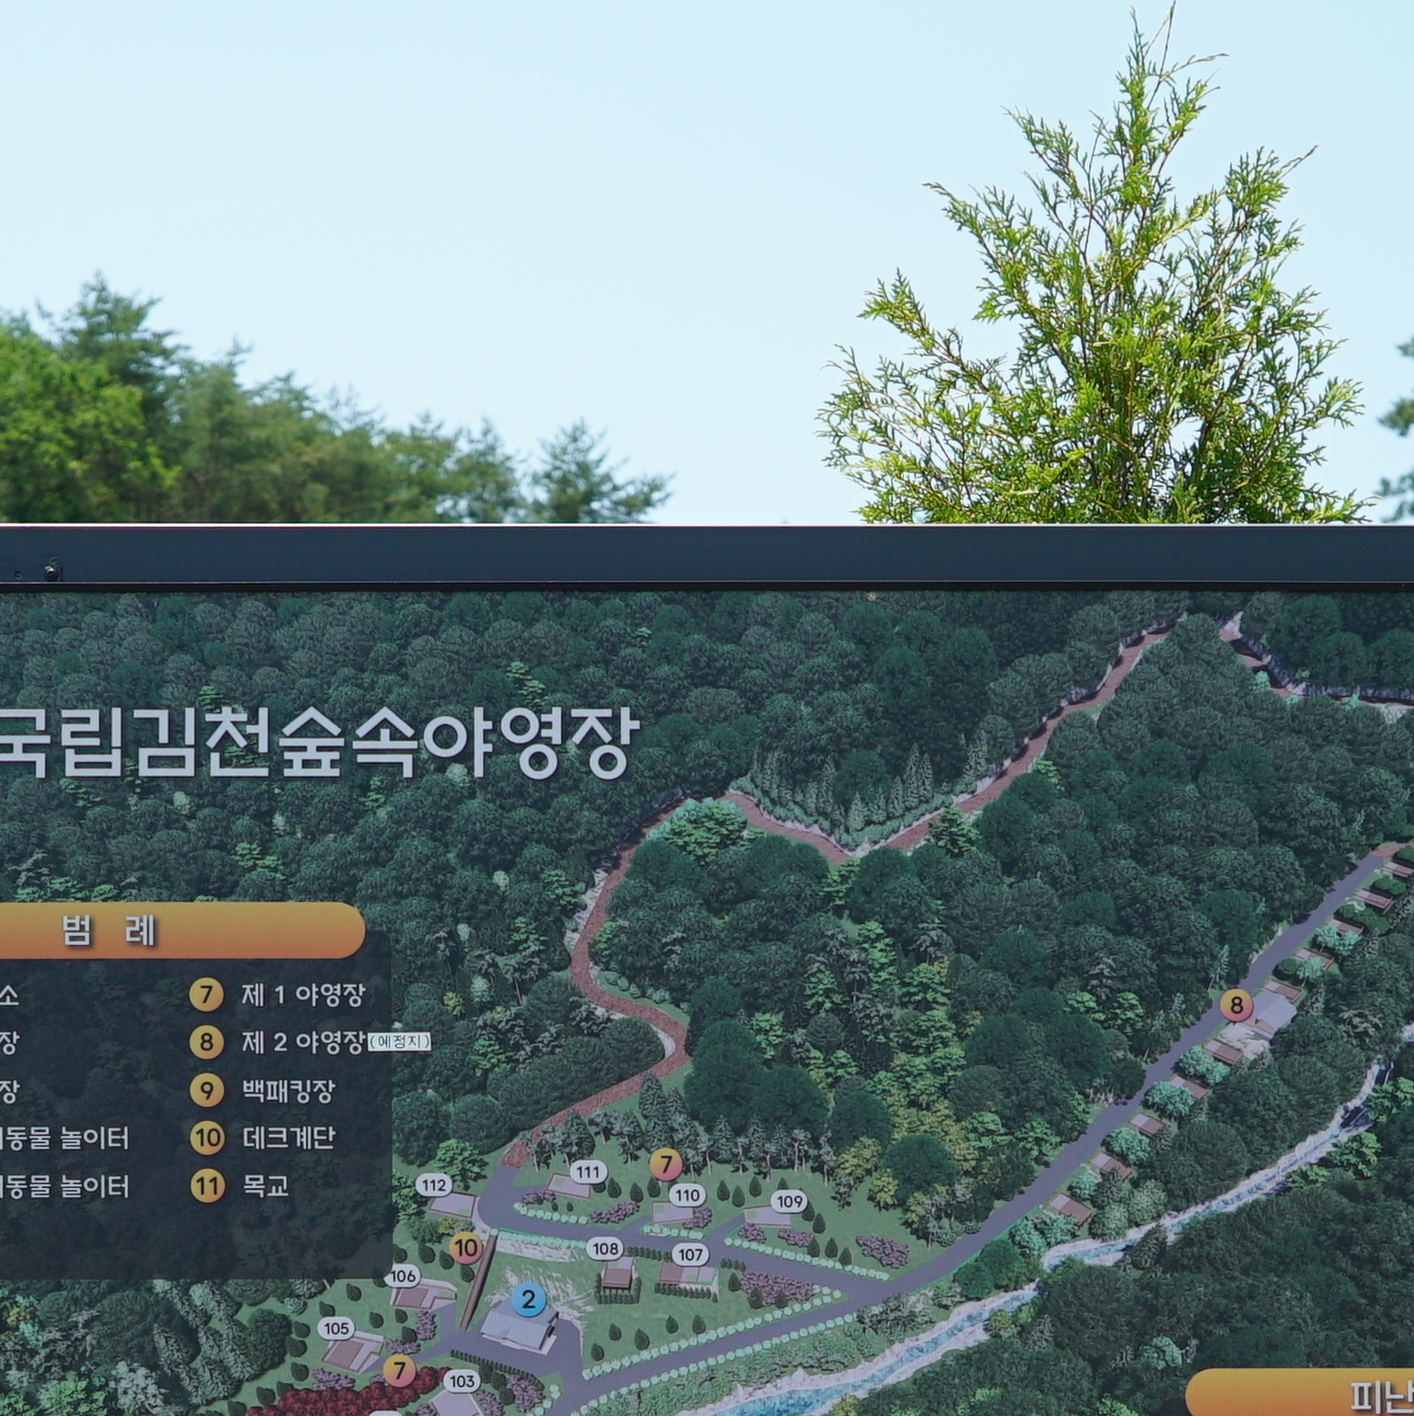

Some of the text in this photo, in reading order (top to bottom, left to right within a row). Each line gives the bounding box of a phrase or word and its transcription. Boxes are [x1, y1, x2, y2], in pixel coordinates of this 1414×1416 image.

[61, 913, 155, 946] 범 례
[200, 983, 367, 1008] 7 제 1 야영장
[1230, 996, 1244, 1015] 8
[200, 1030, 367, 1055] 8 제 2 야영장
[200, 1079, 336, 1104] 9 백패킹장
[60, 1126, 129, 1150] 놀이터
[196, 1126, 336, 1150] 10 데크계단
[577, 1166, 599, 1178] 111
[660, 1155, 673, 1174] 7
[60, 1174, 129, 1199] 놀이터
[196, 1174, 289, 1198] 11 목교
[422, 1178, 446, 1192] 112
[675, 1189, 700, 1202] 110
[777, 1195, 803, 1208] 109
[454, 1238, 478, 1257] 10
[593, 1242, 619, 1256] 108
[677, 1247, 703, 1261] 107
[391, 1269, 416, 1283] 106
[522, 1289, 536, 1309] 2
[324, 1322, 350, 1336] 105
[393, 1361, 406, 1380] 7
[450, 1375, 475, 1389] 103
